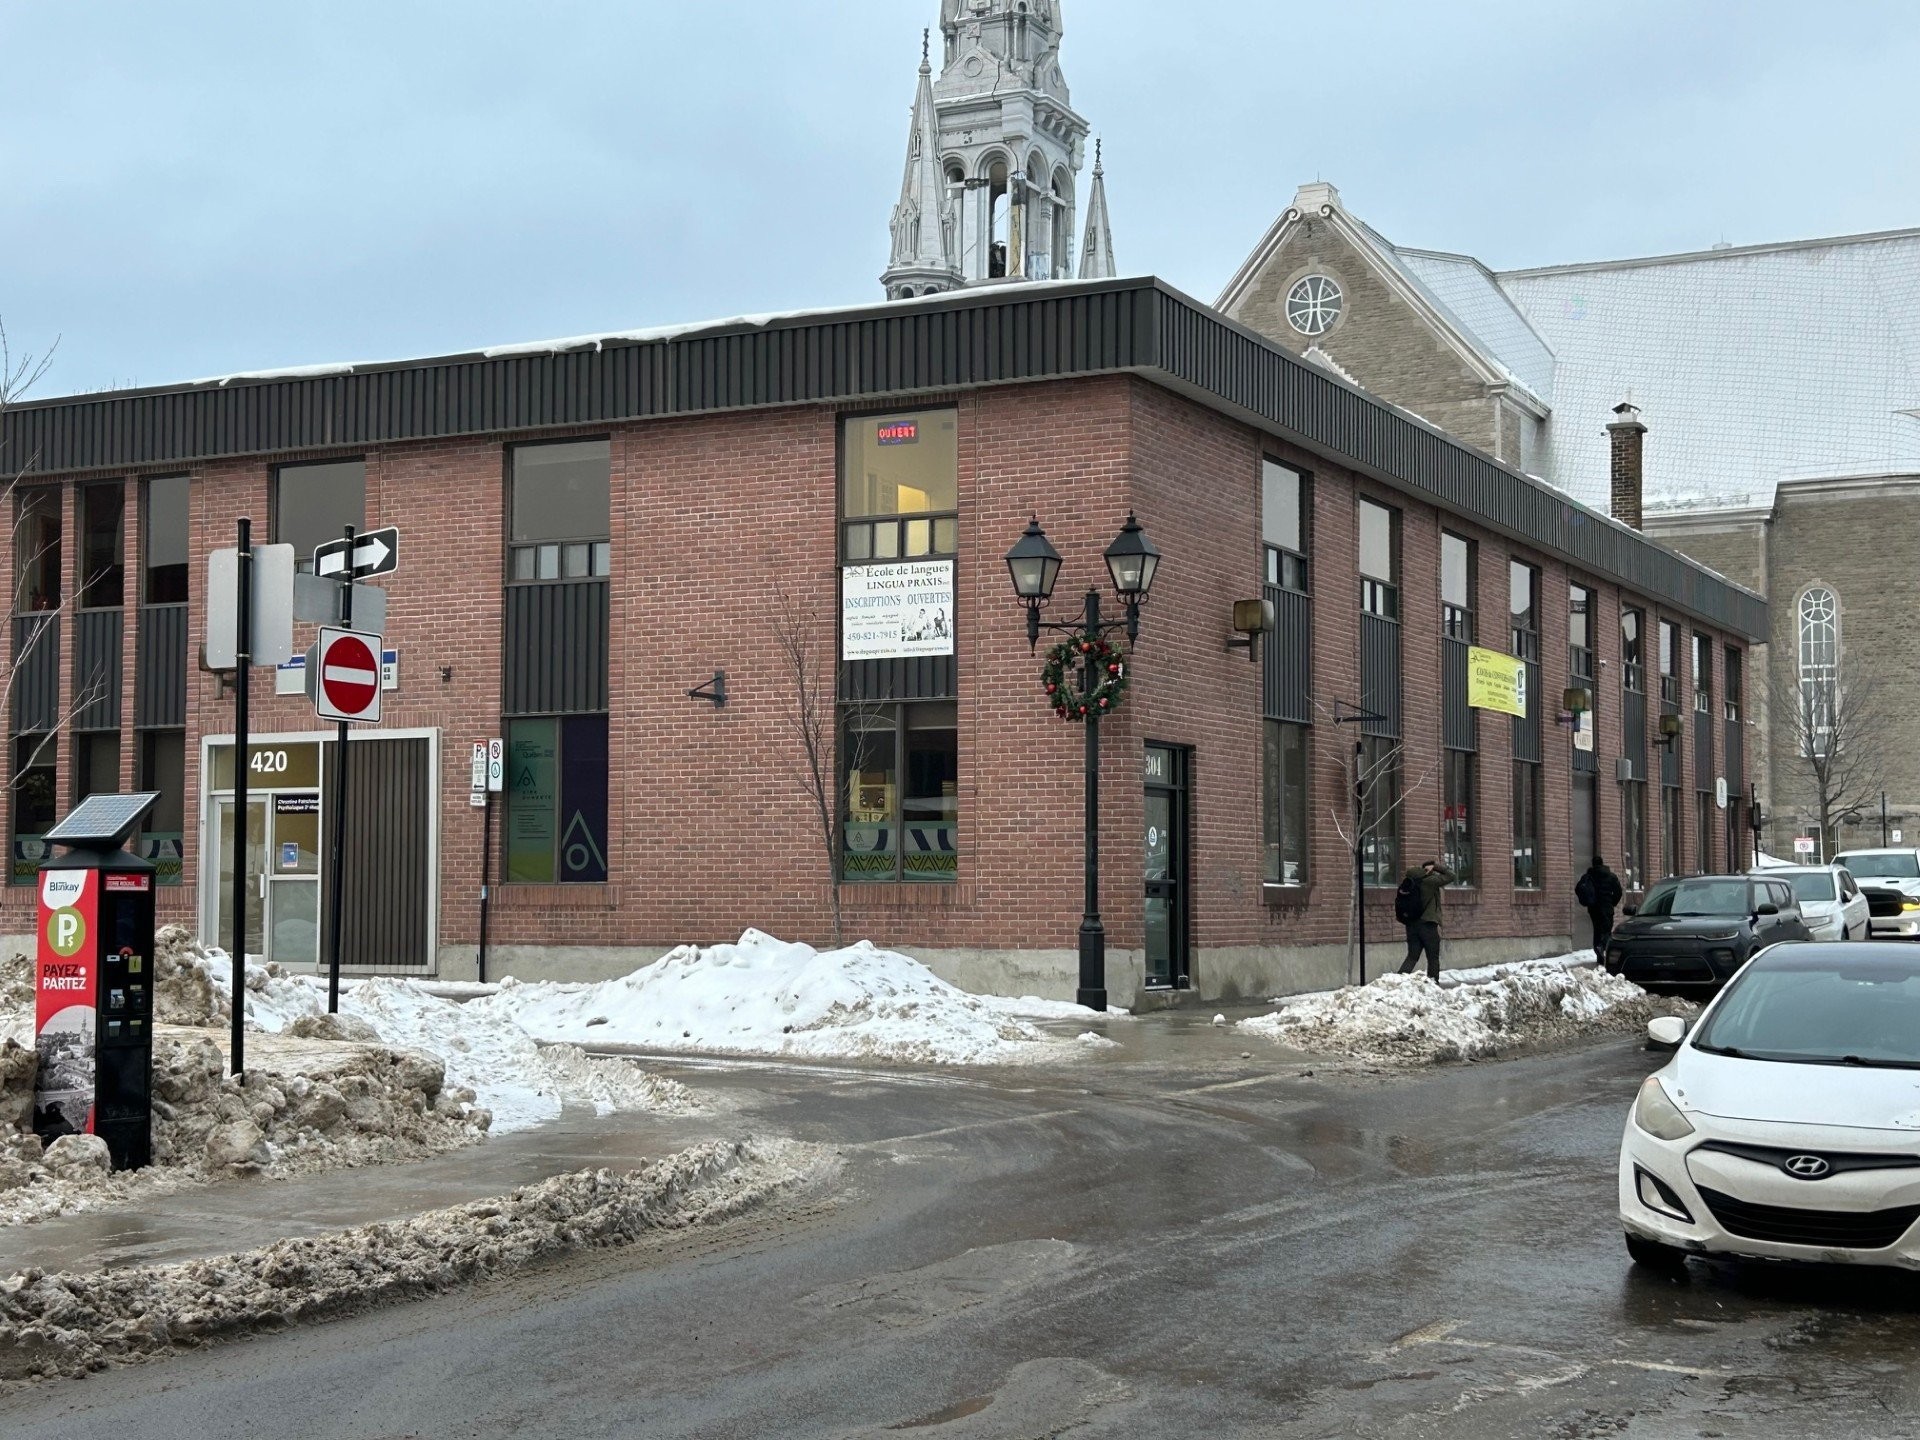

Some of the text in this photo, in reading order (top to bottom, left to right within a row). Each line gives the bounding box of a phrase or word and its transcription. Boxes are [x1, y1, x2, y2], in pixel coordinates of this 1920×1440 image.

[879, 426, 915, 438] OUVERT
[866, 564, 949, 578] École de langues
[867, 580, 905, 590] LINGUA
[845, 595, 901, 609] INSCRIPTIONS
[250, 750, 288, 773] 420
[43, 964, 79, 977] PAYEZ
[43, 977, 87, 990] PARTEZ
